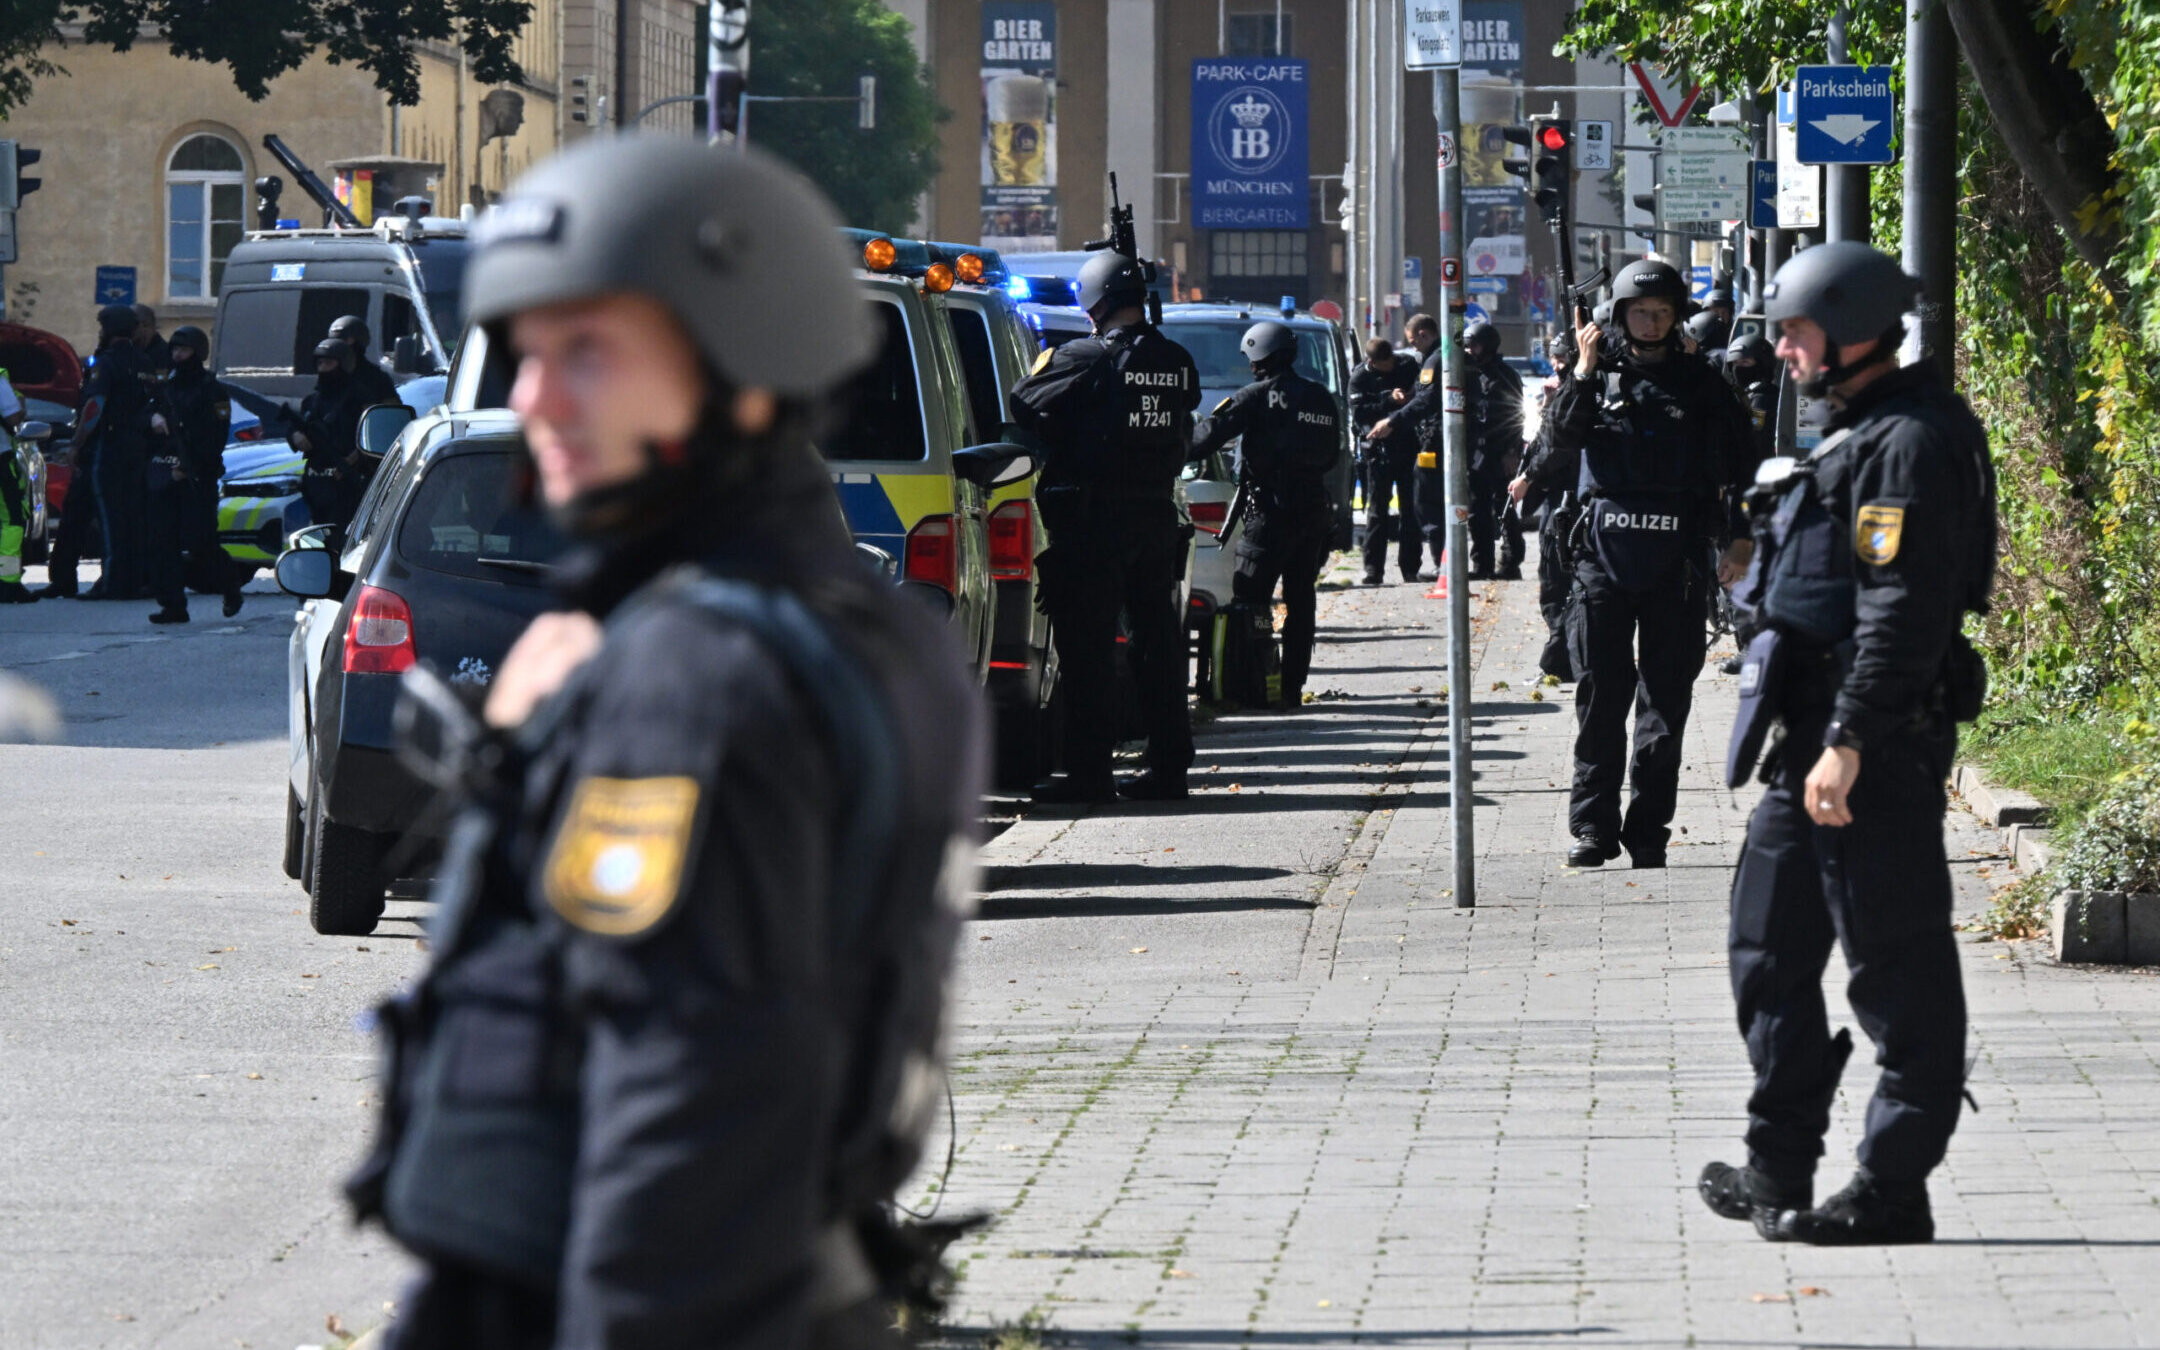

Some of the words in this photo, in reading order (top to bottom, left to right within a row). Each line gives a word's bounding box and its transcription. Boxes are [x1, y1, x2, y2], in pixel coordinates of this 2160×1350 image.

[994, 20, 1042, 39] BIER
[1463, 20, 1509, 40] BIER
[984, 41, 1052, 60] GARTEN
[1463, 43, 1519, 60] ARTEN
[1197, 65, 1303, 81] PARK-CAFE
[1803, 79, 1886, 97] Parkschein
[1231, 128, 1271, 160] HB
[1207, 179, 1293, 195] MÜNCHEN
[1202, 208, 1297, 223] BIERGARTEN
[1125, 371, 1178, 386] POLIZEI
[1142, 395, 1160, 410] BY
[1129, 412, 1140, 427] M
[1144, 411, 1171, 427] 7241
[1298, 411, 1333, 425] POLIZEI
[1604, 513, 1679, 531] POLIZEI
